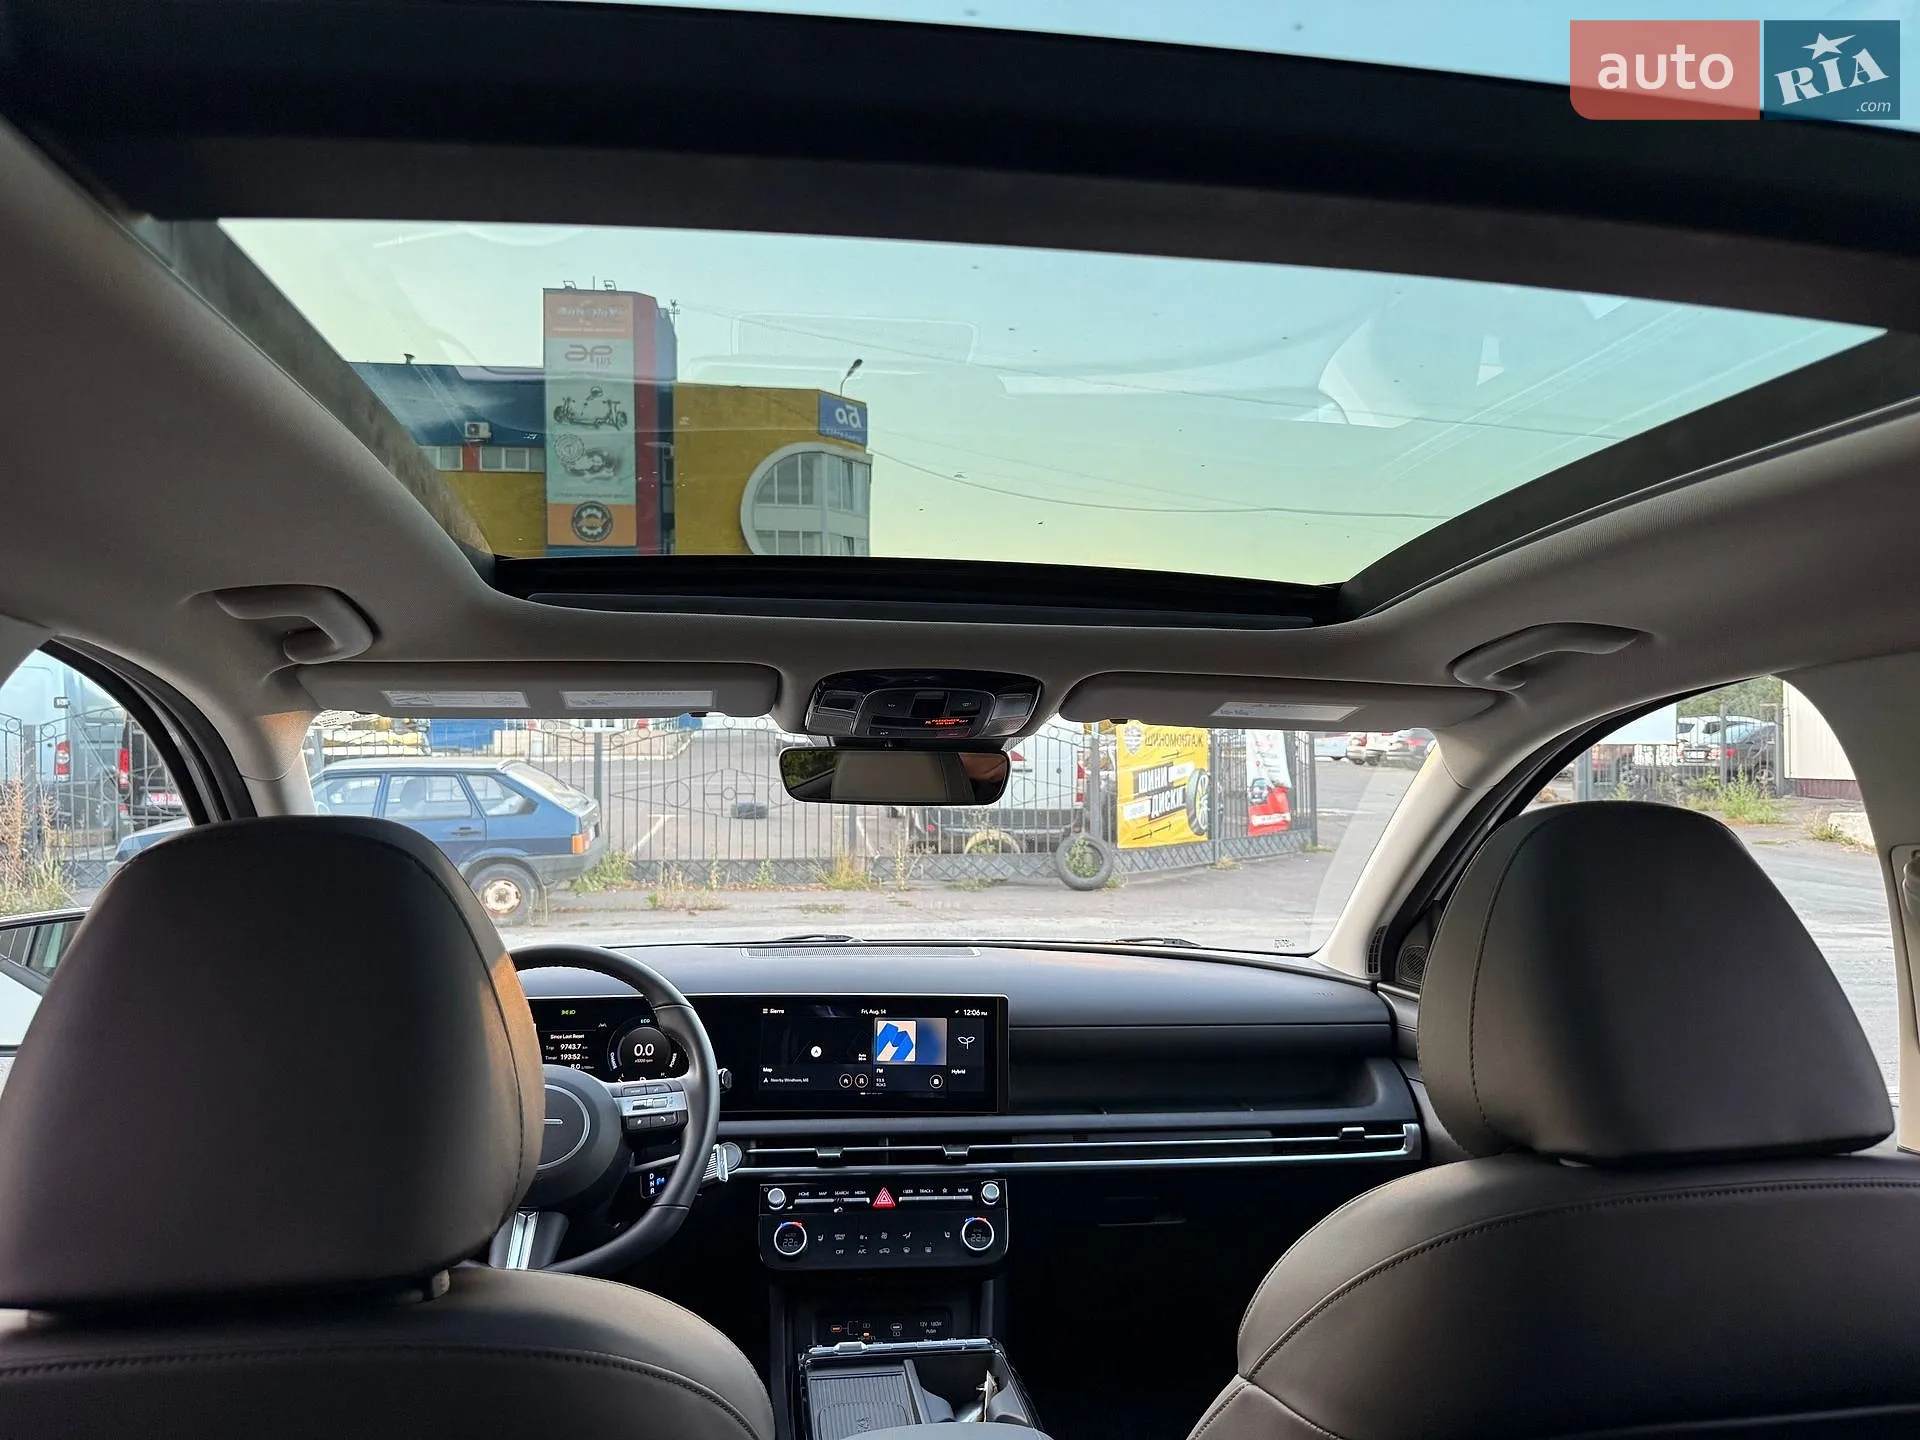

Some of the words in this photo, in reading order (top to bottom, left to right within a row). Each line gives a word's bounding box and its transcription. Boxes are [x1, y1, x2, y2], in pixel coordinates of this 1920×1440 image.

[1145, 732, 1204, 748] ШИНОМОНТАЖ
[1138, 766, 1168, 793] ШИНИ
[1151, 787, 1184, 819] ДИСКИ
[633, 1043, 655, 1057] 0.0
